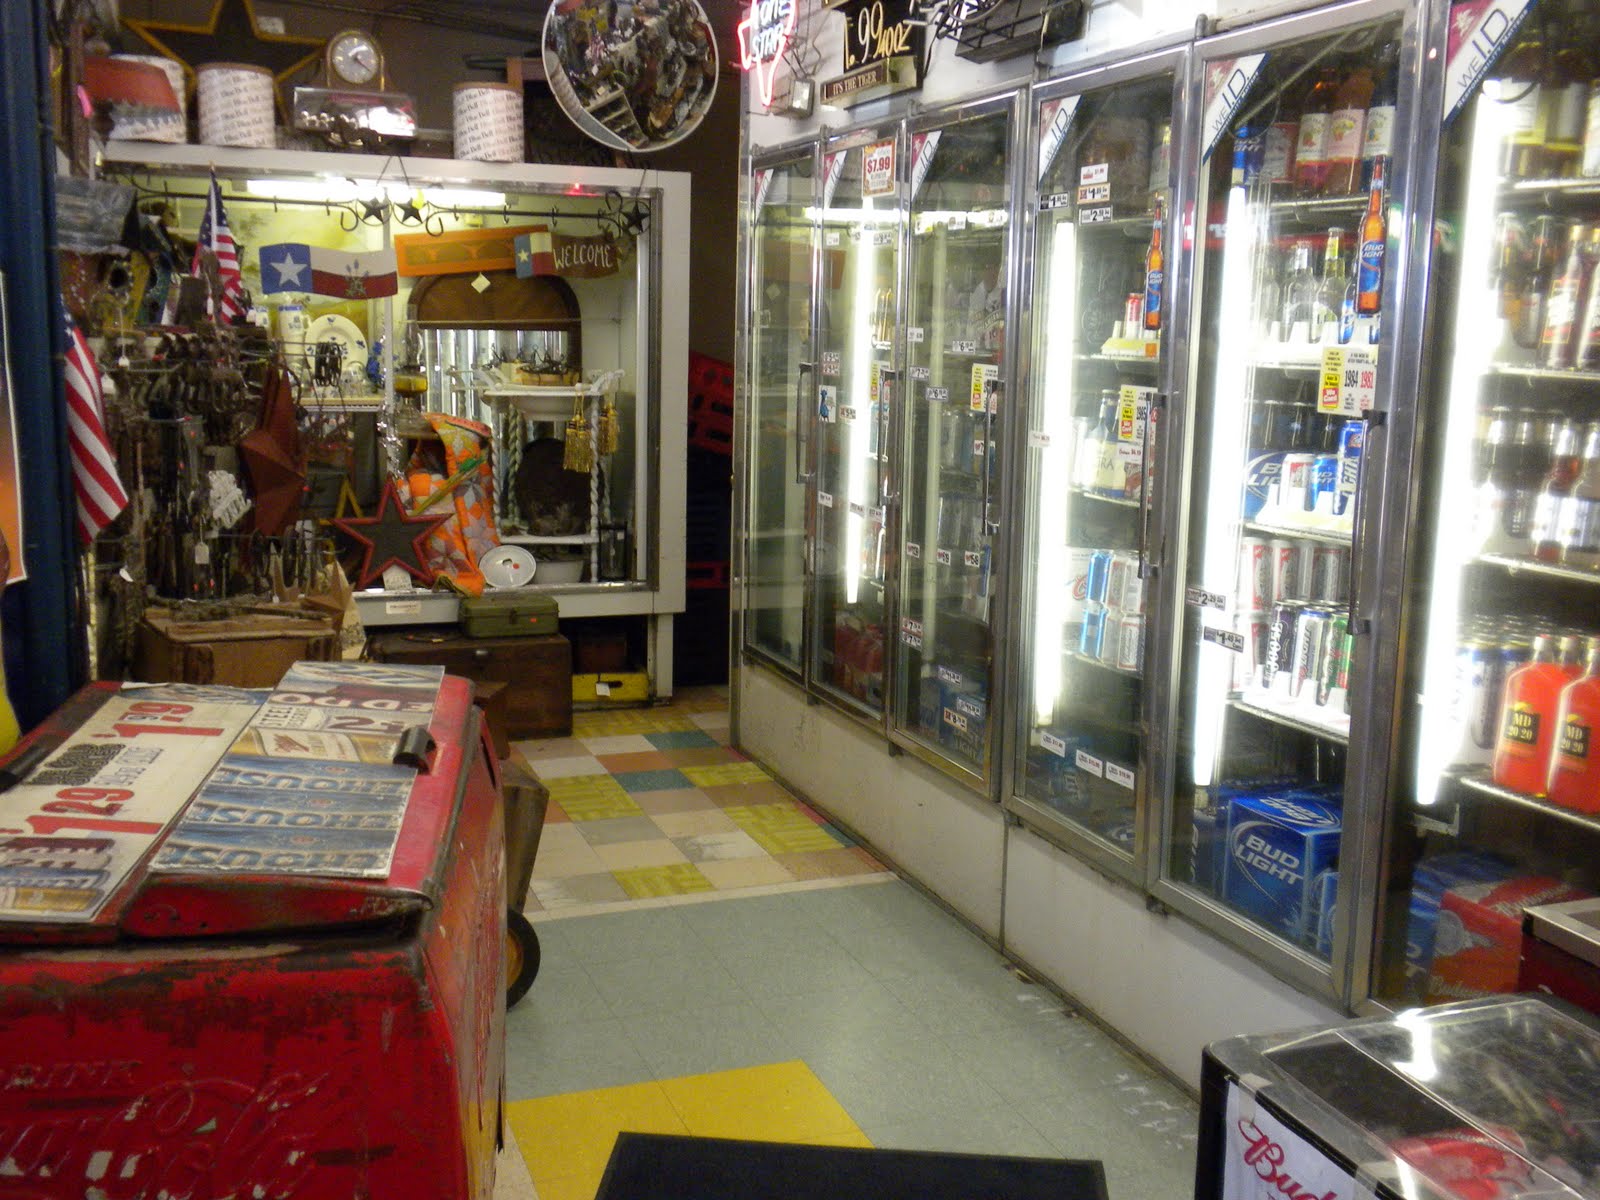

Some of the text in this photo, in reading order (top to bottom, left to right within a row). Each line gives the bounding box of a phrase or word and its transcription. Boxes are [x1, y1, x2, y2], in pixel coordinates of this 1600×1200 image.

[752, 23, 784, 60] STAR
[1458, 8, 1515, 88] WE I.D.
[1456, 9, 1528, 108] RESPONSIBILITY MATTERS
[845, 79, 857, 92] THE
[858, 71, 877, 88] TIGER
[1212, 68, 1250, 131] WE I.D.
[868, 156, 891, 174] $7.99
[552, 243, 614, 270] WELCOME
[1361, 250, 1384, 258] LIGHT
[1363, 244, 1384, 252] BUD
[1344, 370, 1359, 388] 1984
[1360, 371, 1374, 389] 1981
[1512, 712, 1532, 728] MD
[1520, 729, 1533, 741] 20
[1566, 724, 1583, 741] MD
[1560, 738, 1584, 754] 20 20
[1245, 834, 1300, 868] BUD
[1235, 850, 1304, 885] LIGHT
[1238, 1119, 1338, 1200] Bu
